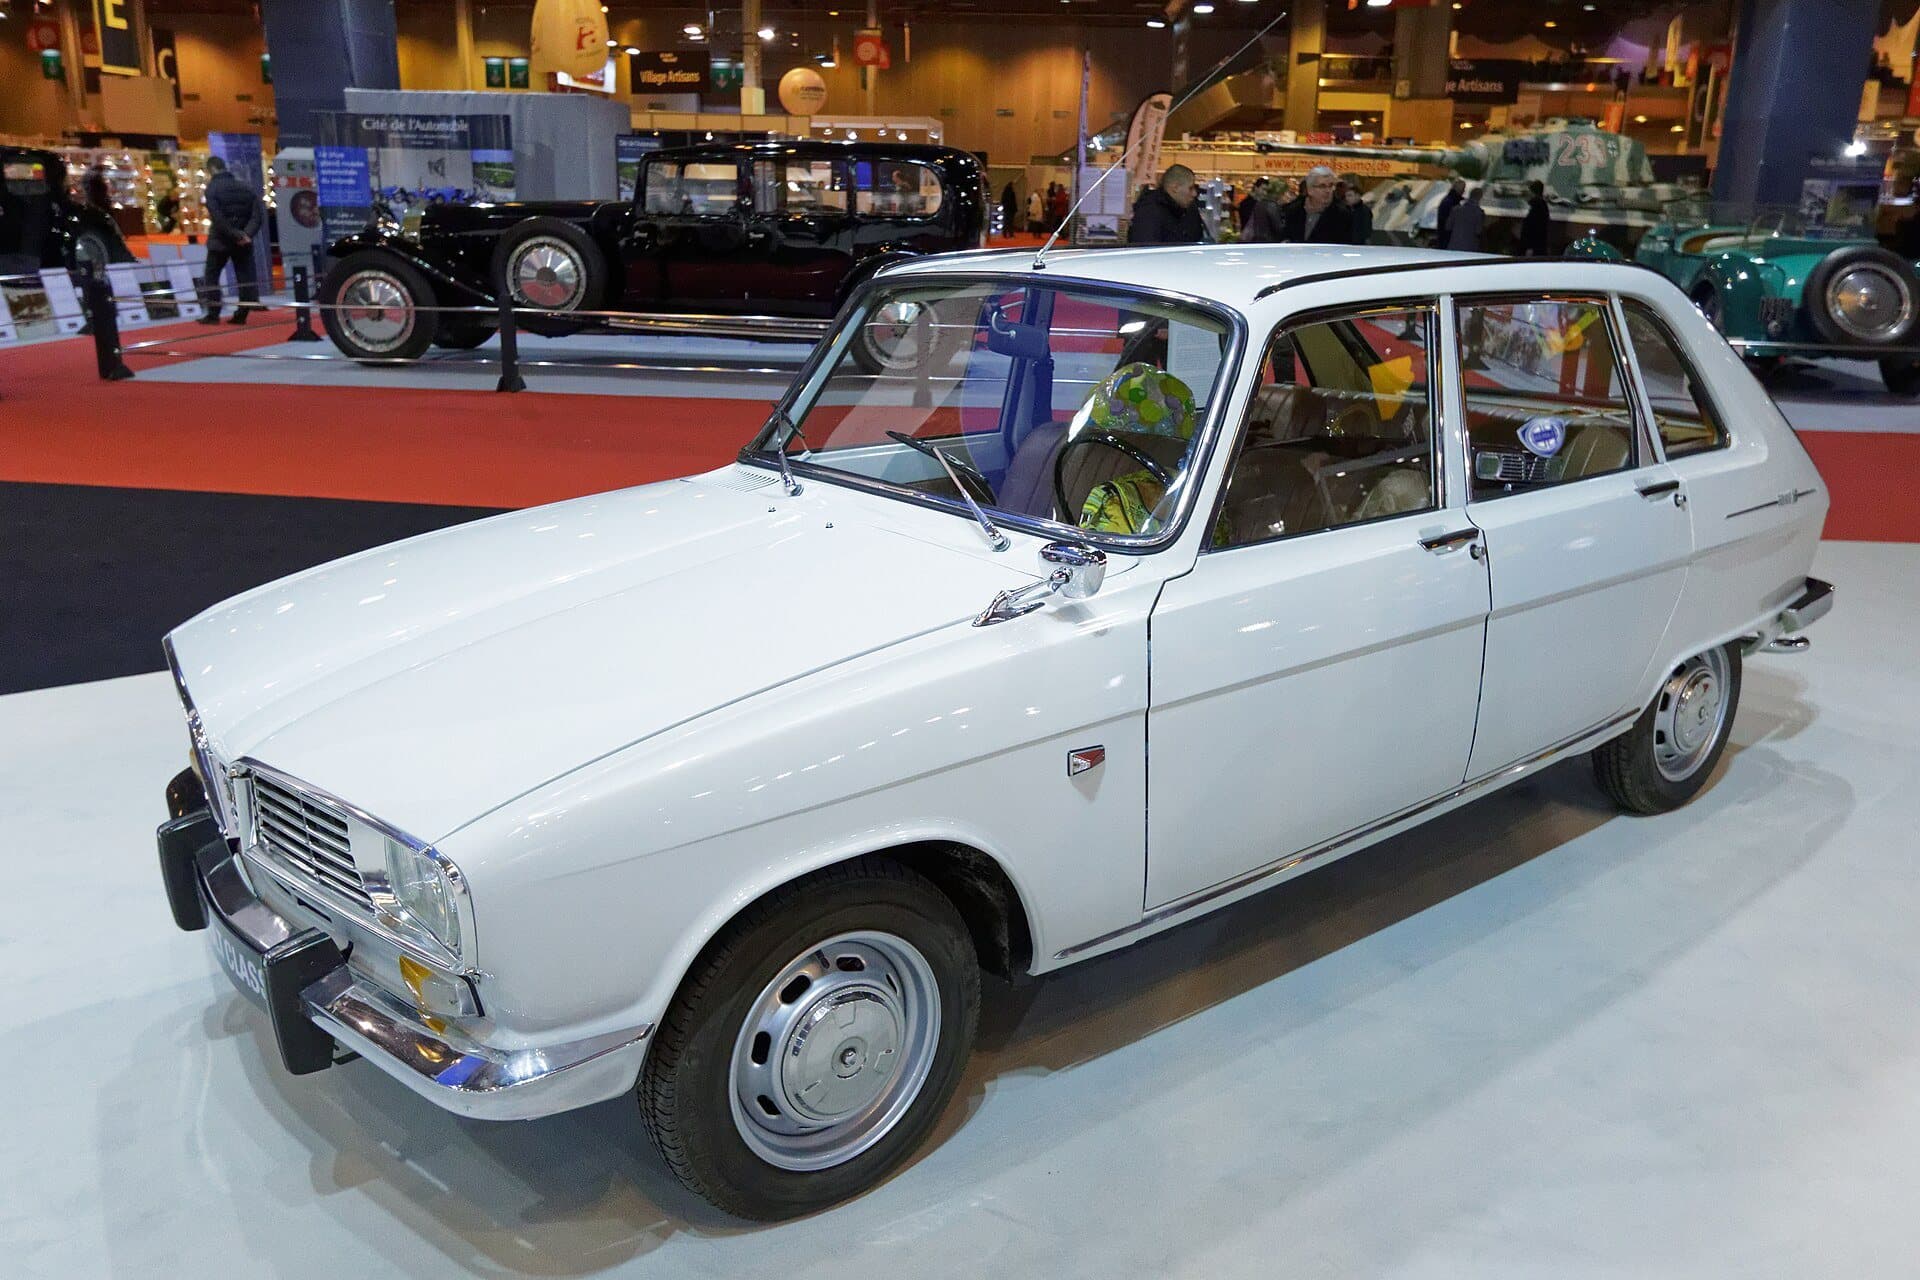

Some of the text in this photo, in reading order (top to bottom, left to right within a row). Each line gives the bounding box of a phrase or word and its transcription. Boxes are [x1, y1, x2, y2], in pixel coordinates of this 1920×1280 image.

[640, 69, 700, 86] Village Artisans
[1457, 78, 1504, 93] Artisans
[390, 118, 406, 131] de
